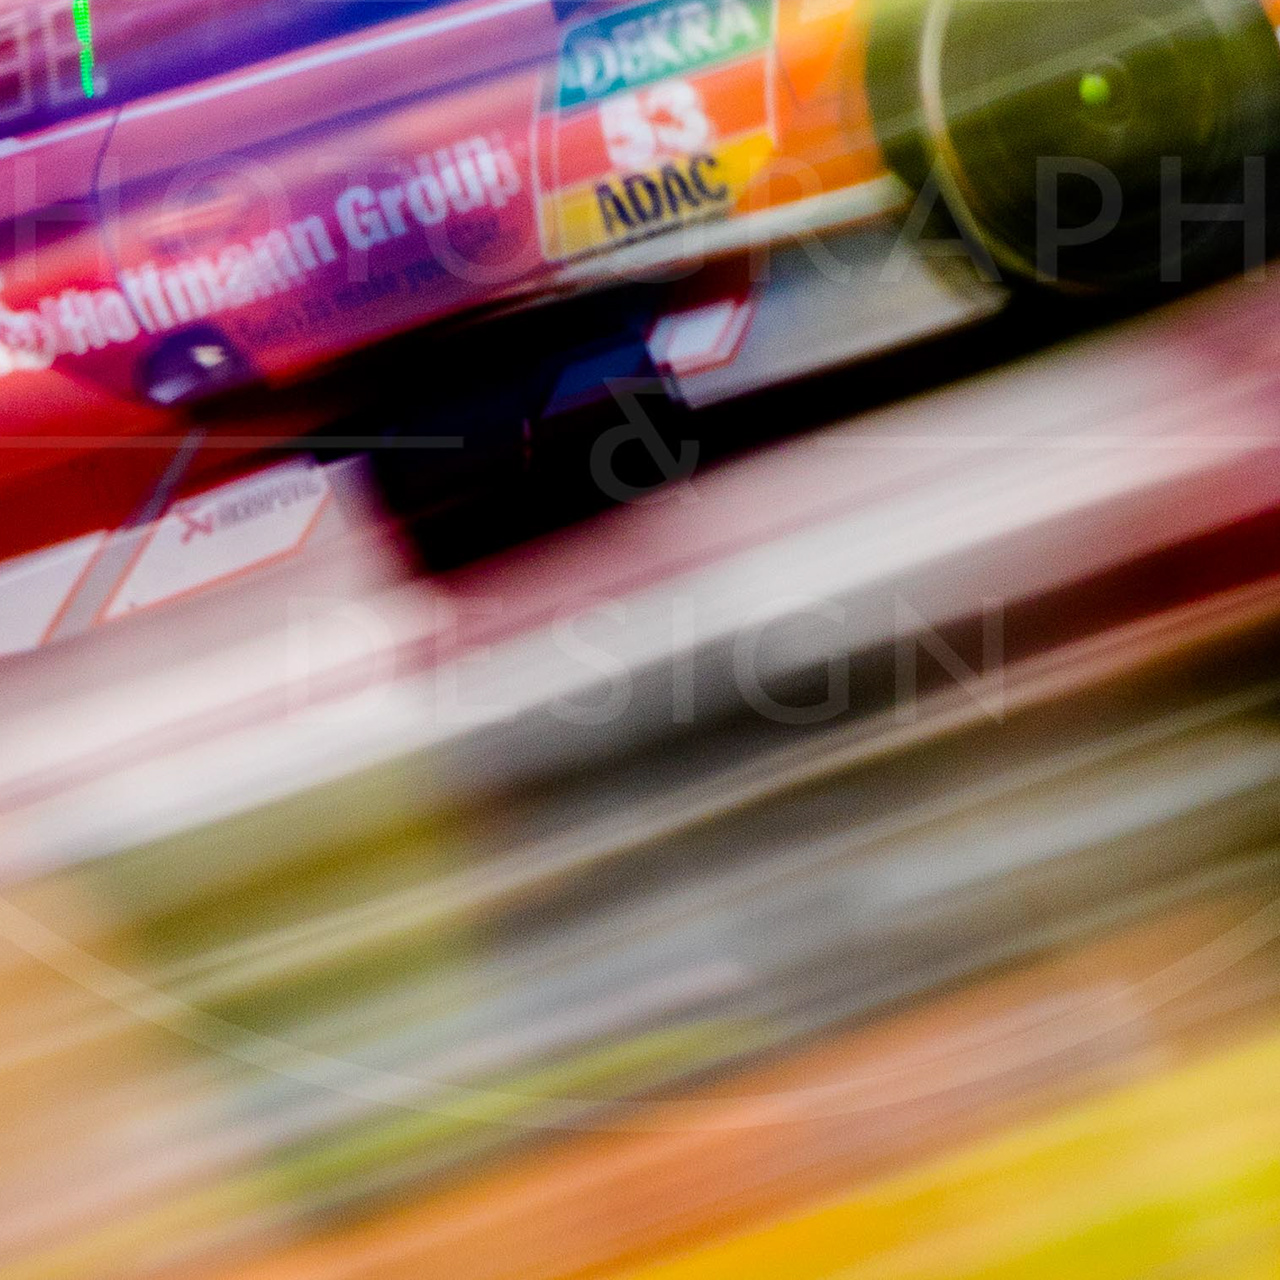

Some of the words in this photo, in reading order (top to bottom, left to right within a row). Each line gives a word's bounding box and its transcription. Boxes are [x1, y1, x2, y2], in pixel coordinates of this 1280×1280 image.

[598, 78, 710, 169] 53
[594, 152, 729, 234] ADAC
[42, 214, 337, 358] Hoffmann
[336, 134, 518, 250] Group
